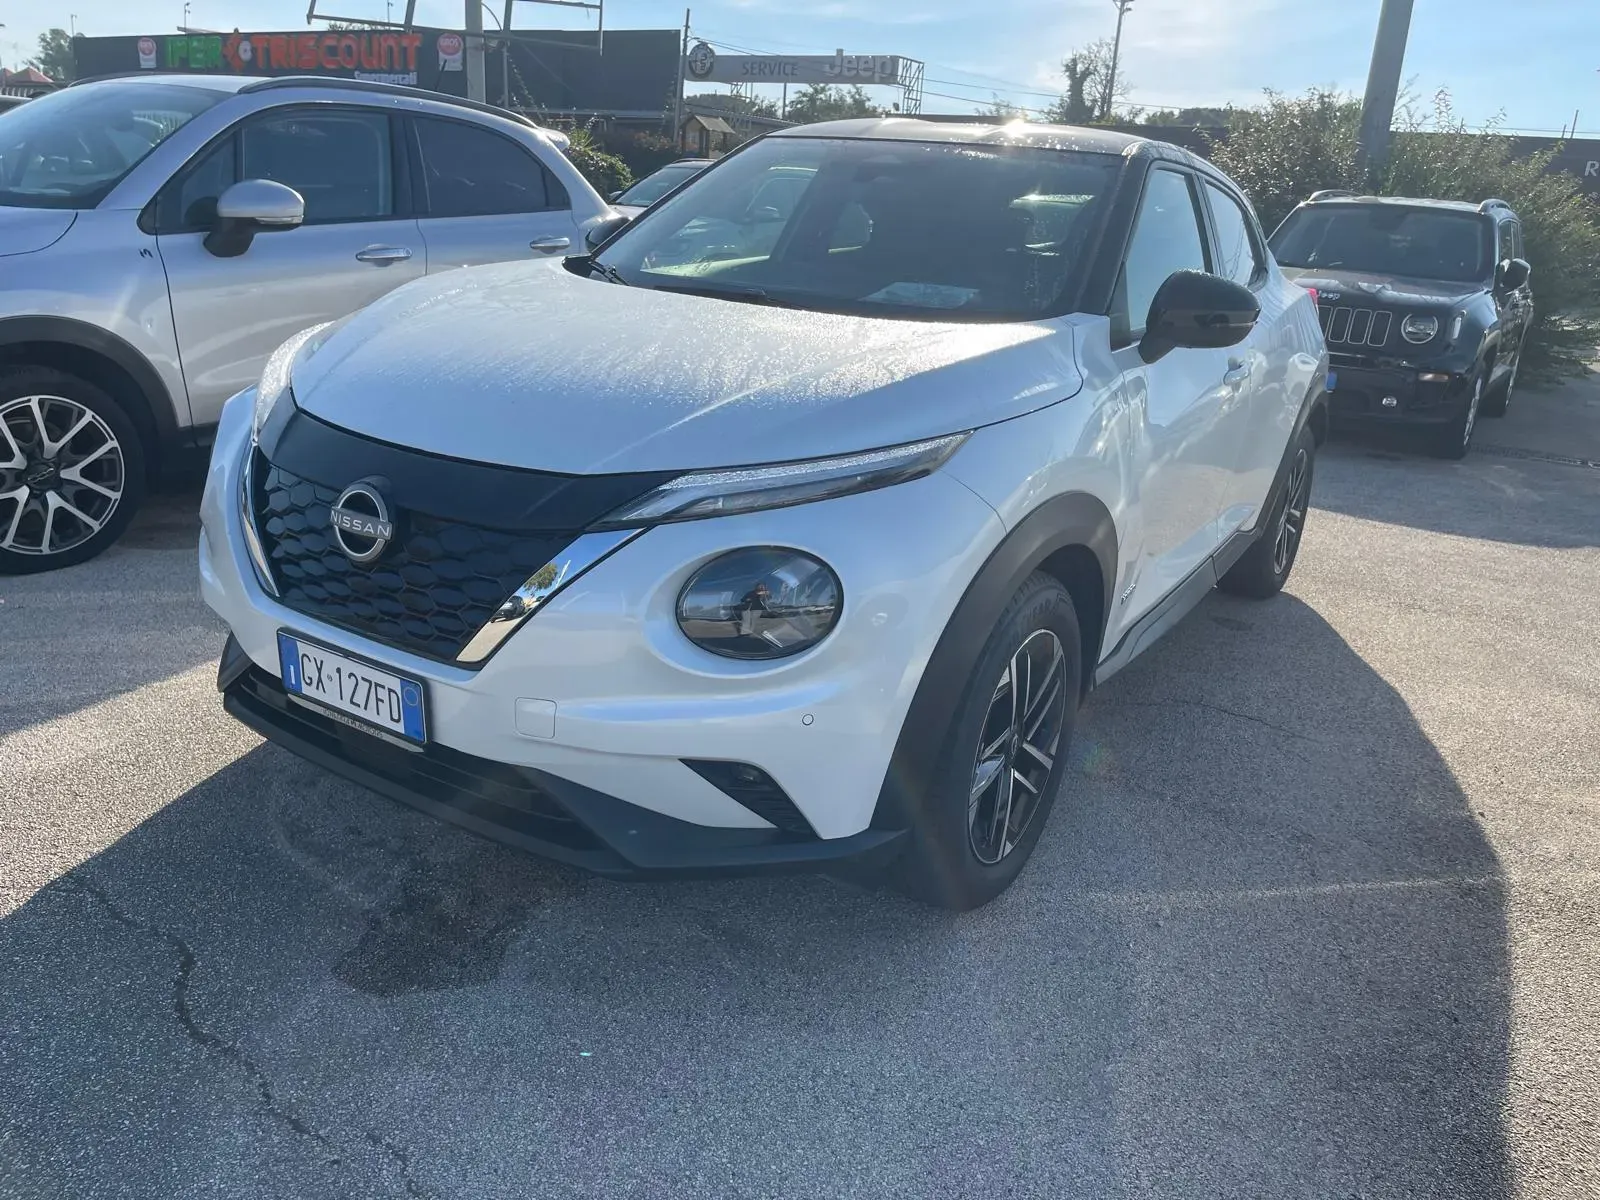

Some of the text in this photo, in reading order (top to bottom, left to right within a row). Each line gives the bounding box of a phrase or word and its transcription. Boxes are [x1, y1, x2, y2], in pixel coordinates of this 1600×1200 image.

[251, 34, 423, 70] TRISCOUNT
[826, 48, 894, 83] Jeep
[742, 60, 799, 77] SERVICE
[330, 509, 390, 537] NISSAN
